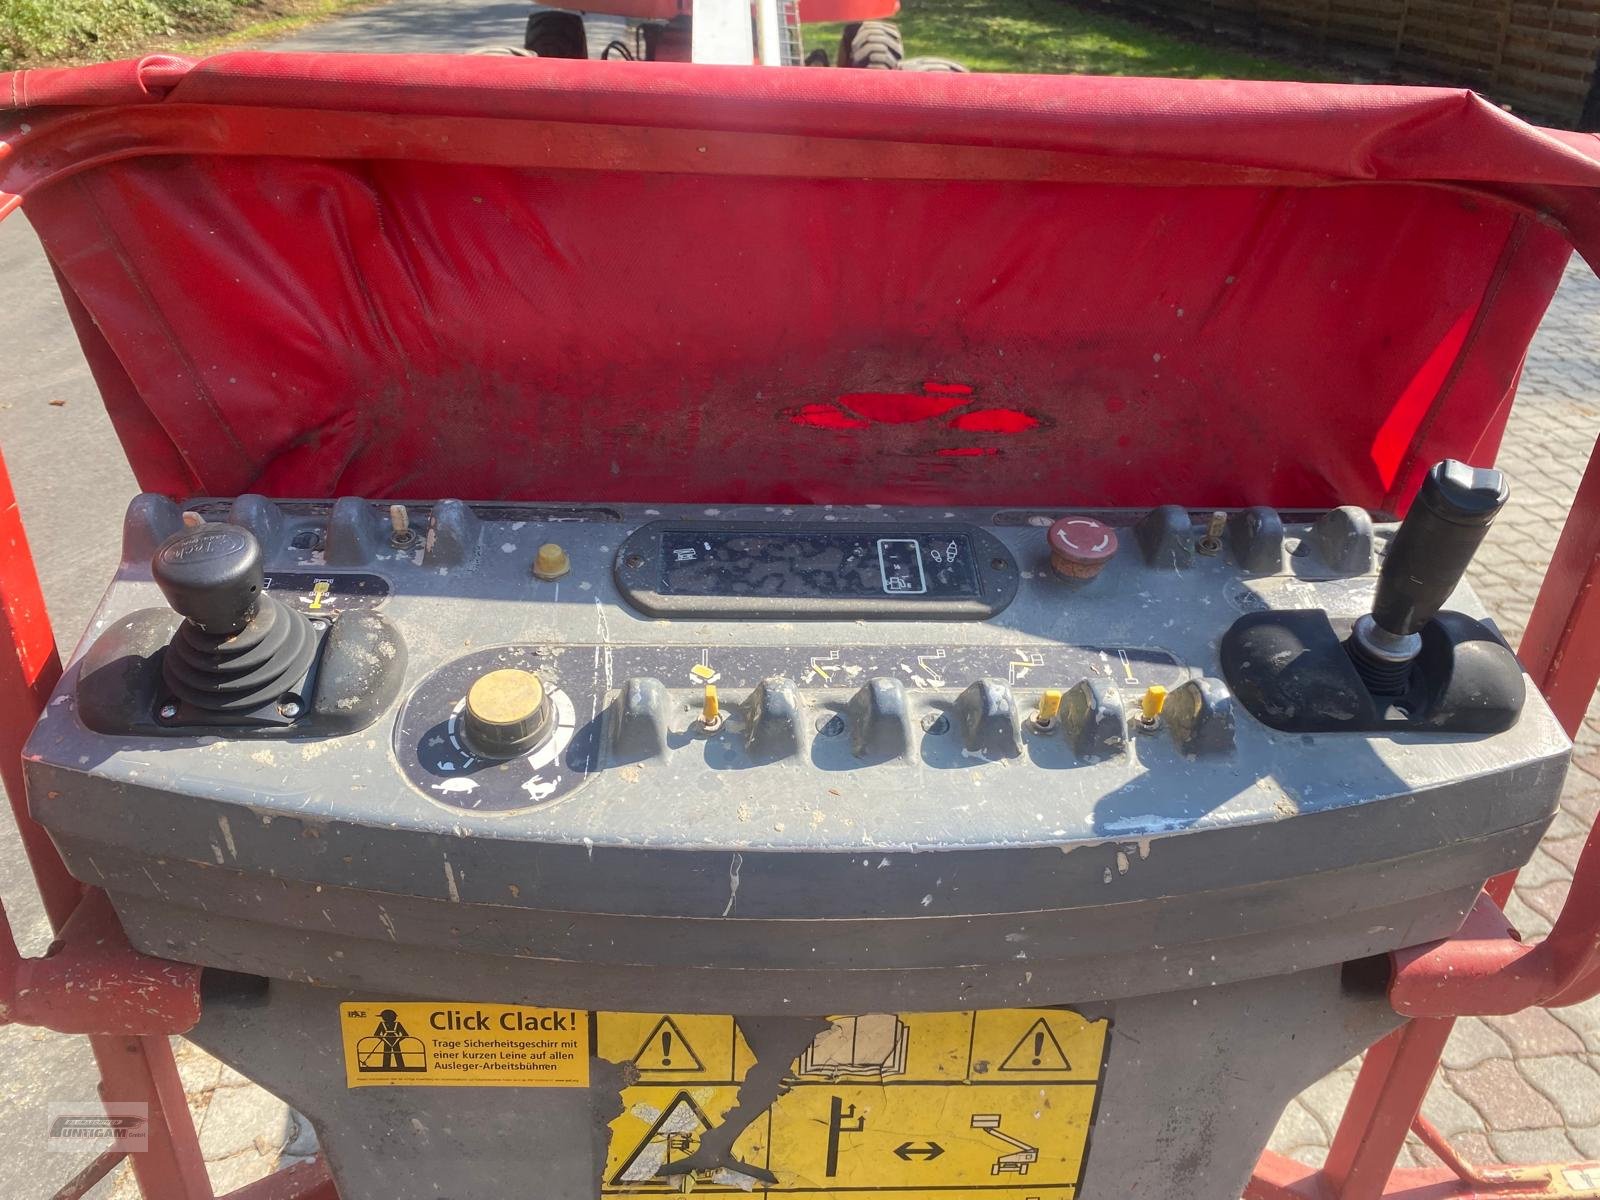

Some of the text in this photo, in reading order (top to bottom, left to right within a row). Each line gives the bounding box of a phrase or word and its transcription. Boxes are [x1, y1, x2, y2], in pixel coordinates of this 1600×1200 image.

[429, 1010, 576, 1031] Click Clack!
[432, 1039, 577, 1050] Trage Sicherheitsgeschirr mit
[433, 1050, 574, 1060] einer kurzen Leine auf allen
[434, 1061, 557, 1072] Ausleger-Arbeitsbühnen
